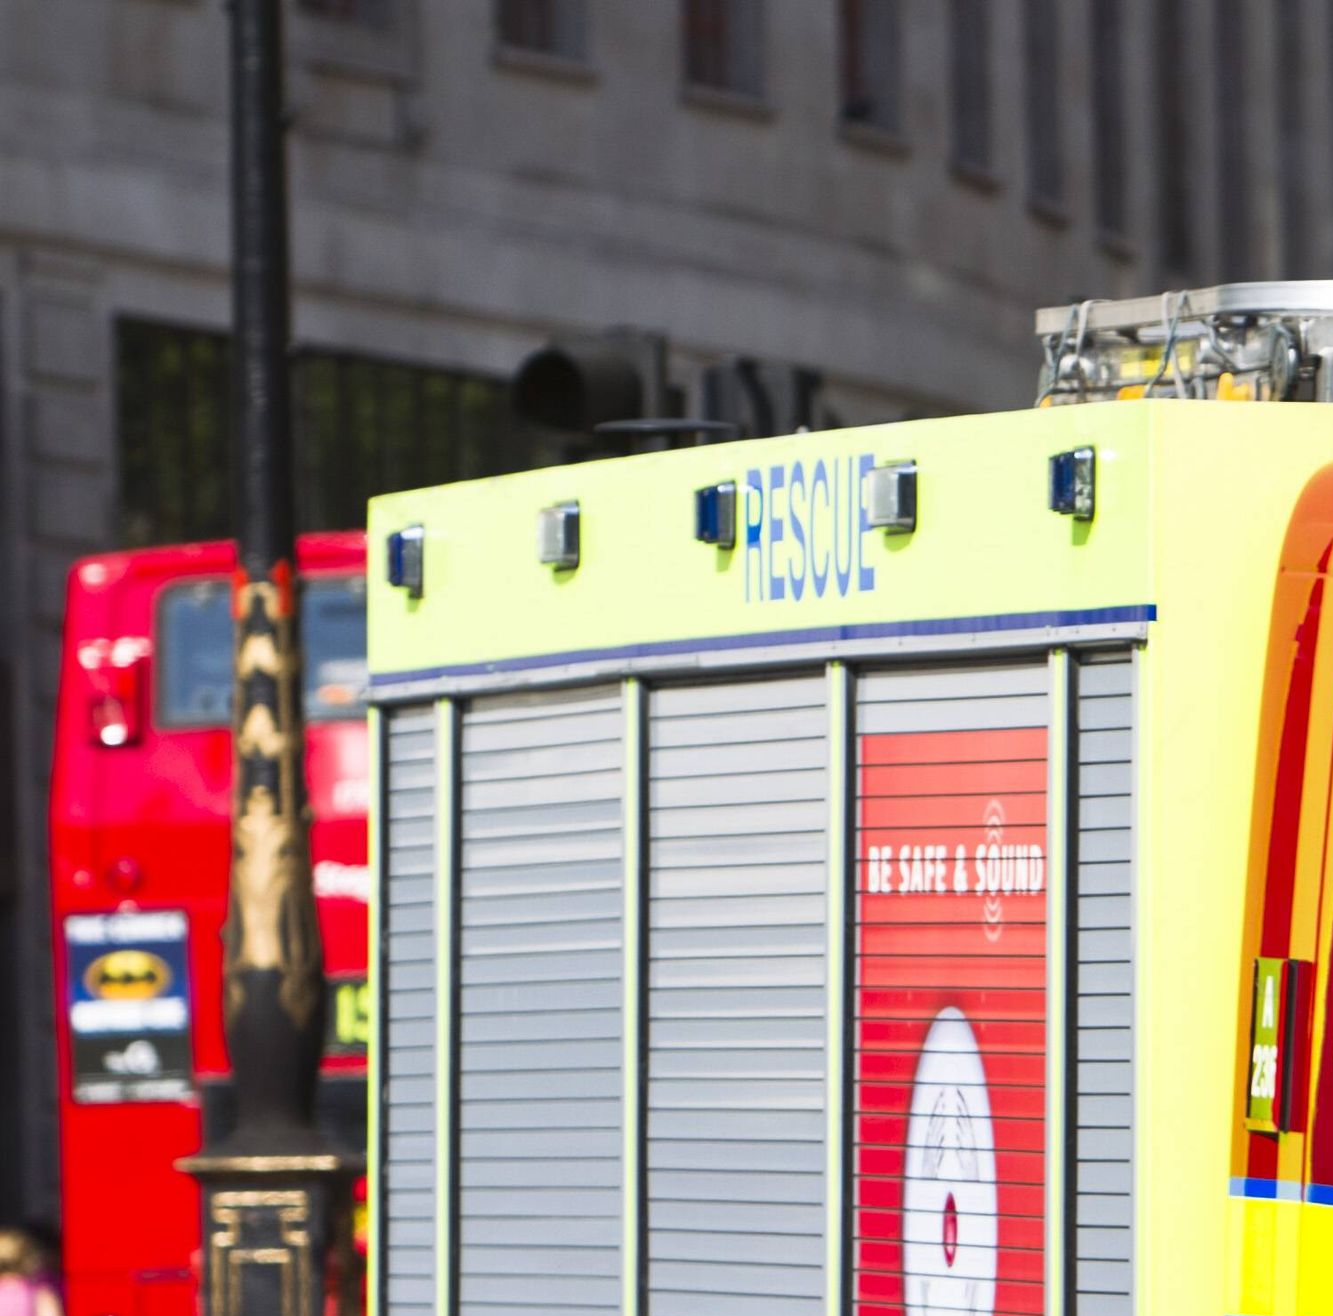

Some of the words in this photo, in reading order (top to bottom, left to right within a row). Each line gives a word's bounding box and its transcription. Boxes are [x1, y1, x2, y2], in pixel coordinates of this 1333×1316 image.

[746, 453, 876, 603] RESCUE
[868, 845, 893, 893] BE
[899, 844, 948, 896] SAFE
[974, 842, 1045, 896] SOUND
[1261, 975, 1274, 1029] A
